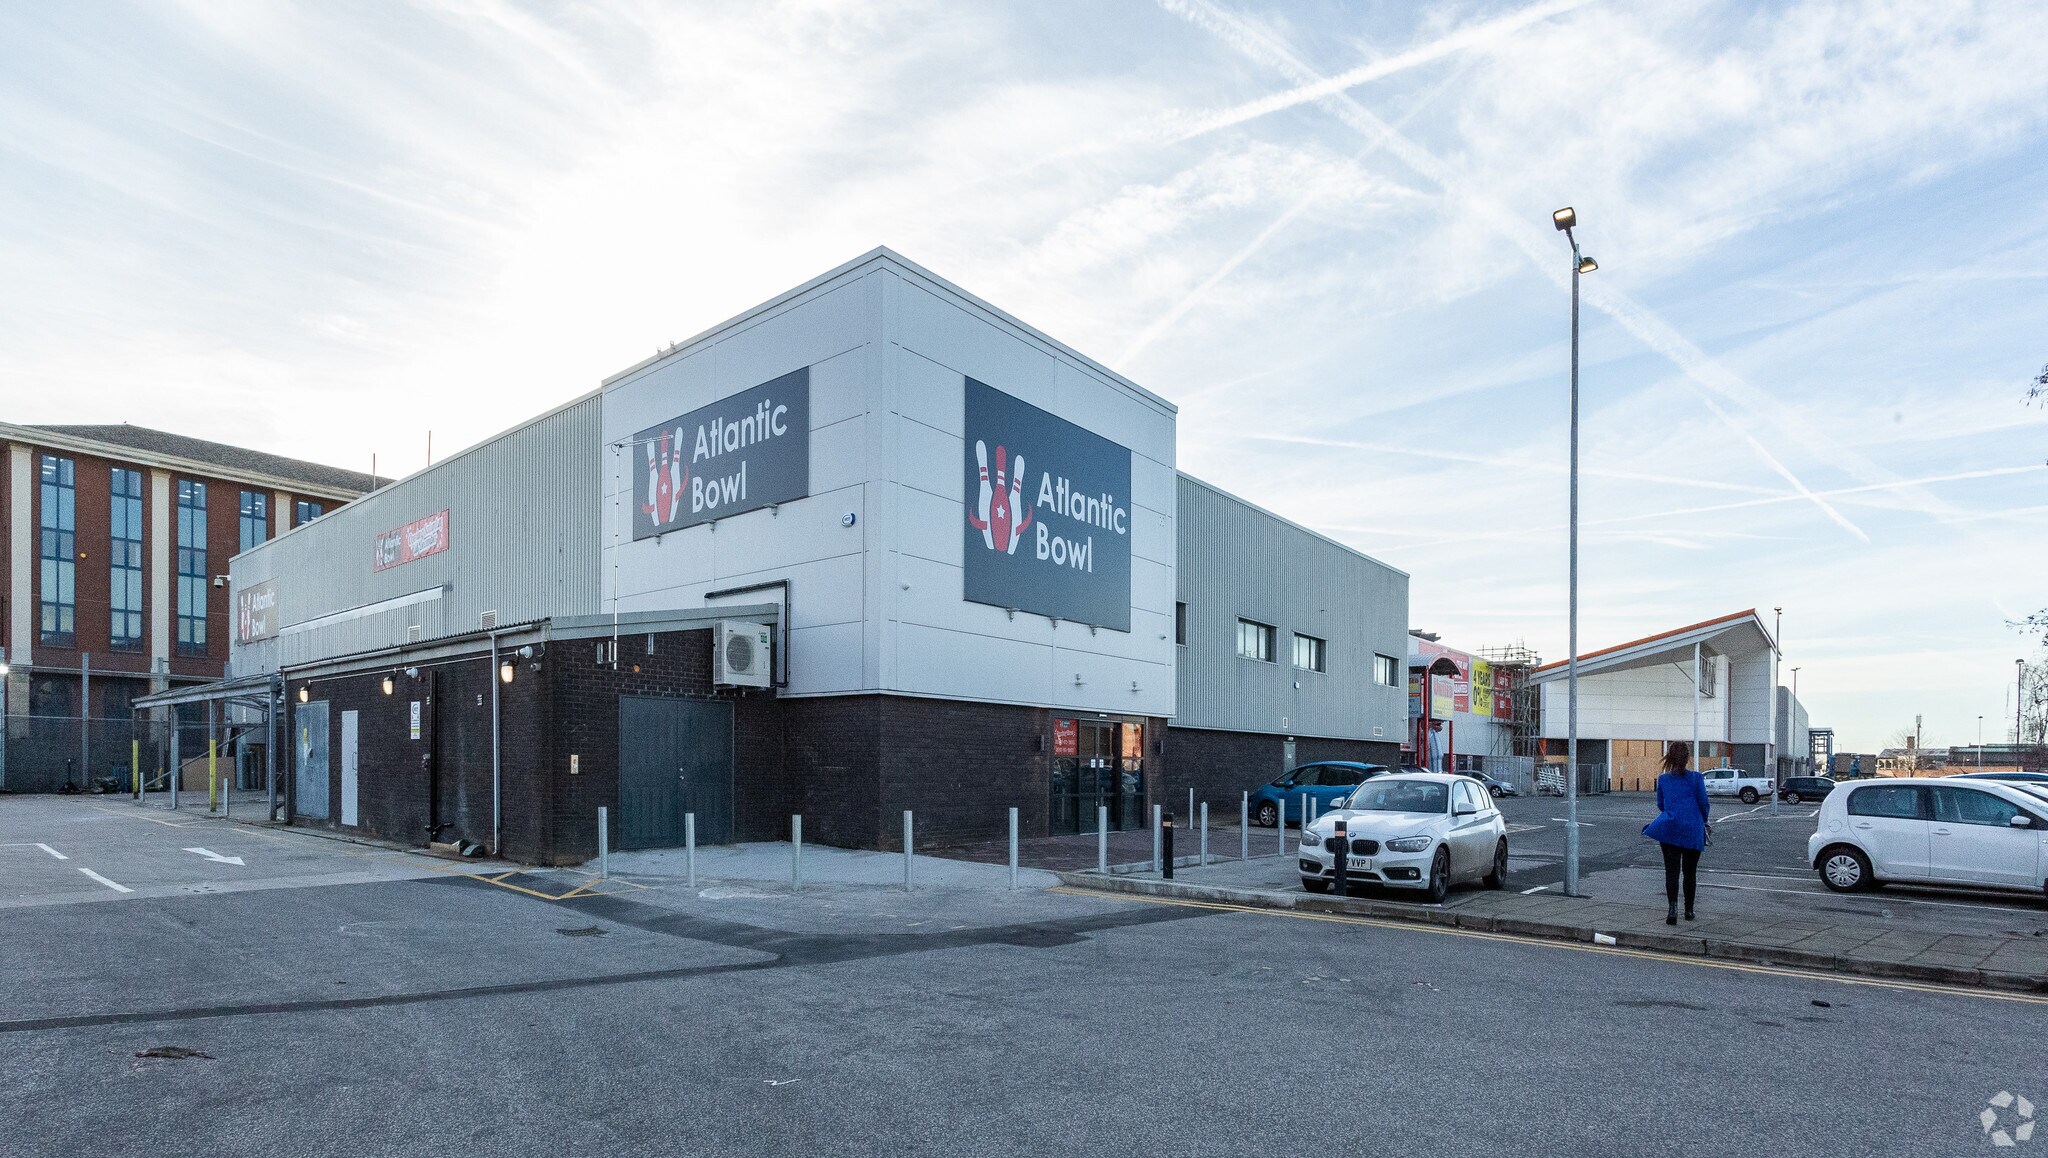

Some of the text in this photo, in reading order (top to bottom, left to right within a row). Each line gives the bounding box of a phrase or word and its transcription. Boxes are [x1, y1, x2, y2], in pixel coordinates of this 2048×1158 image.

[692, 398, 788, 464] Atlantic
[692, 460, 747, 514] Bowl
[1036, 471, 1127, 536] Atlantic
[1036, 521, 1093, 573] Bowl
[251, 614, 266, 637] Bowl
[252, 588, 275, 612] Atlantic
[1351, 858, 1366, 867] VVP
